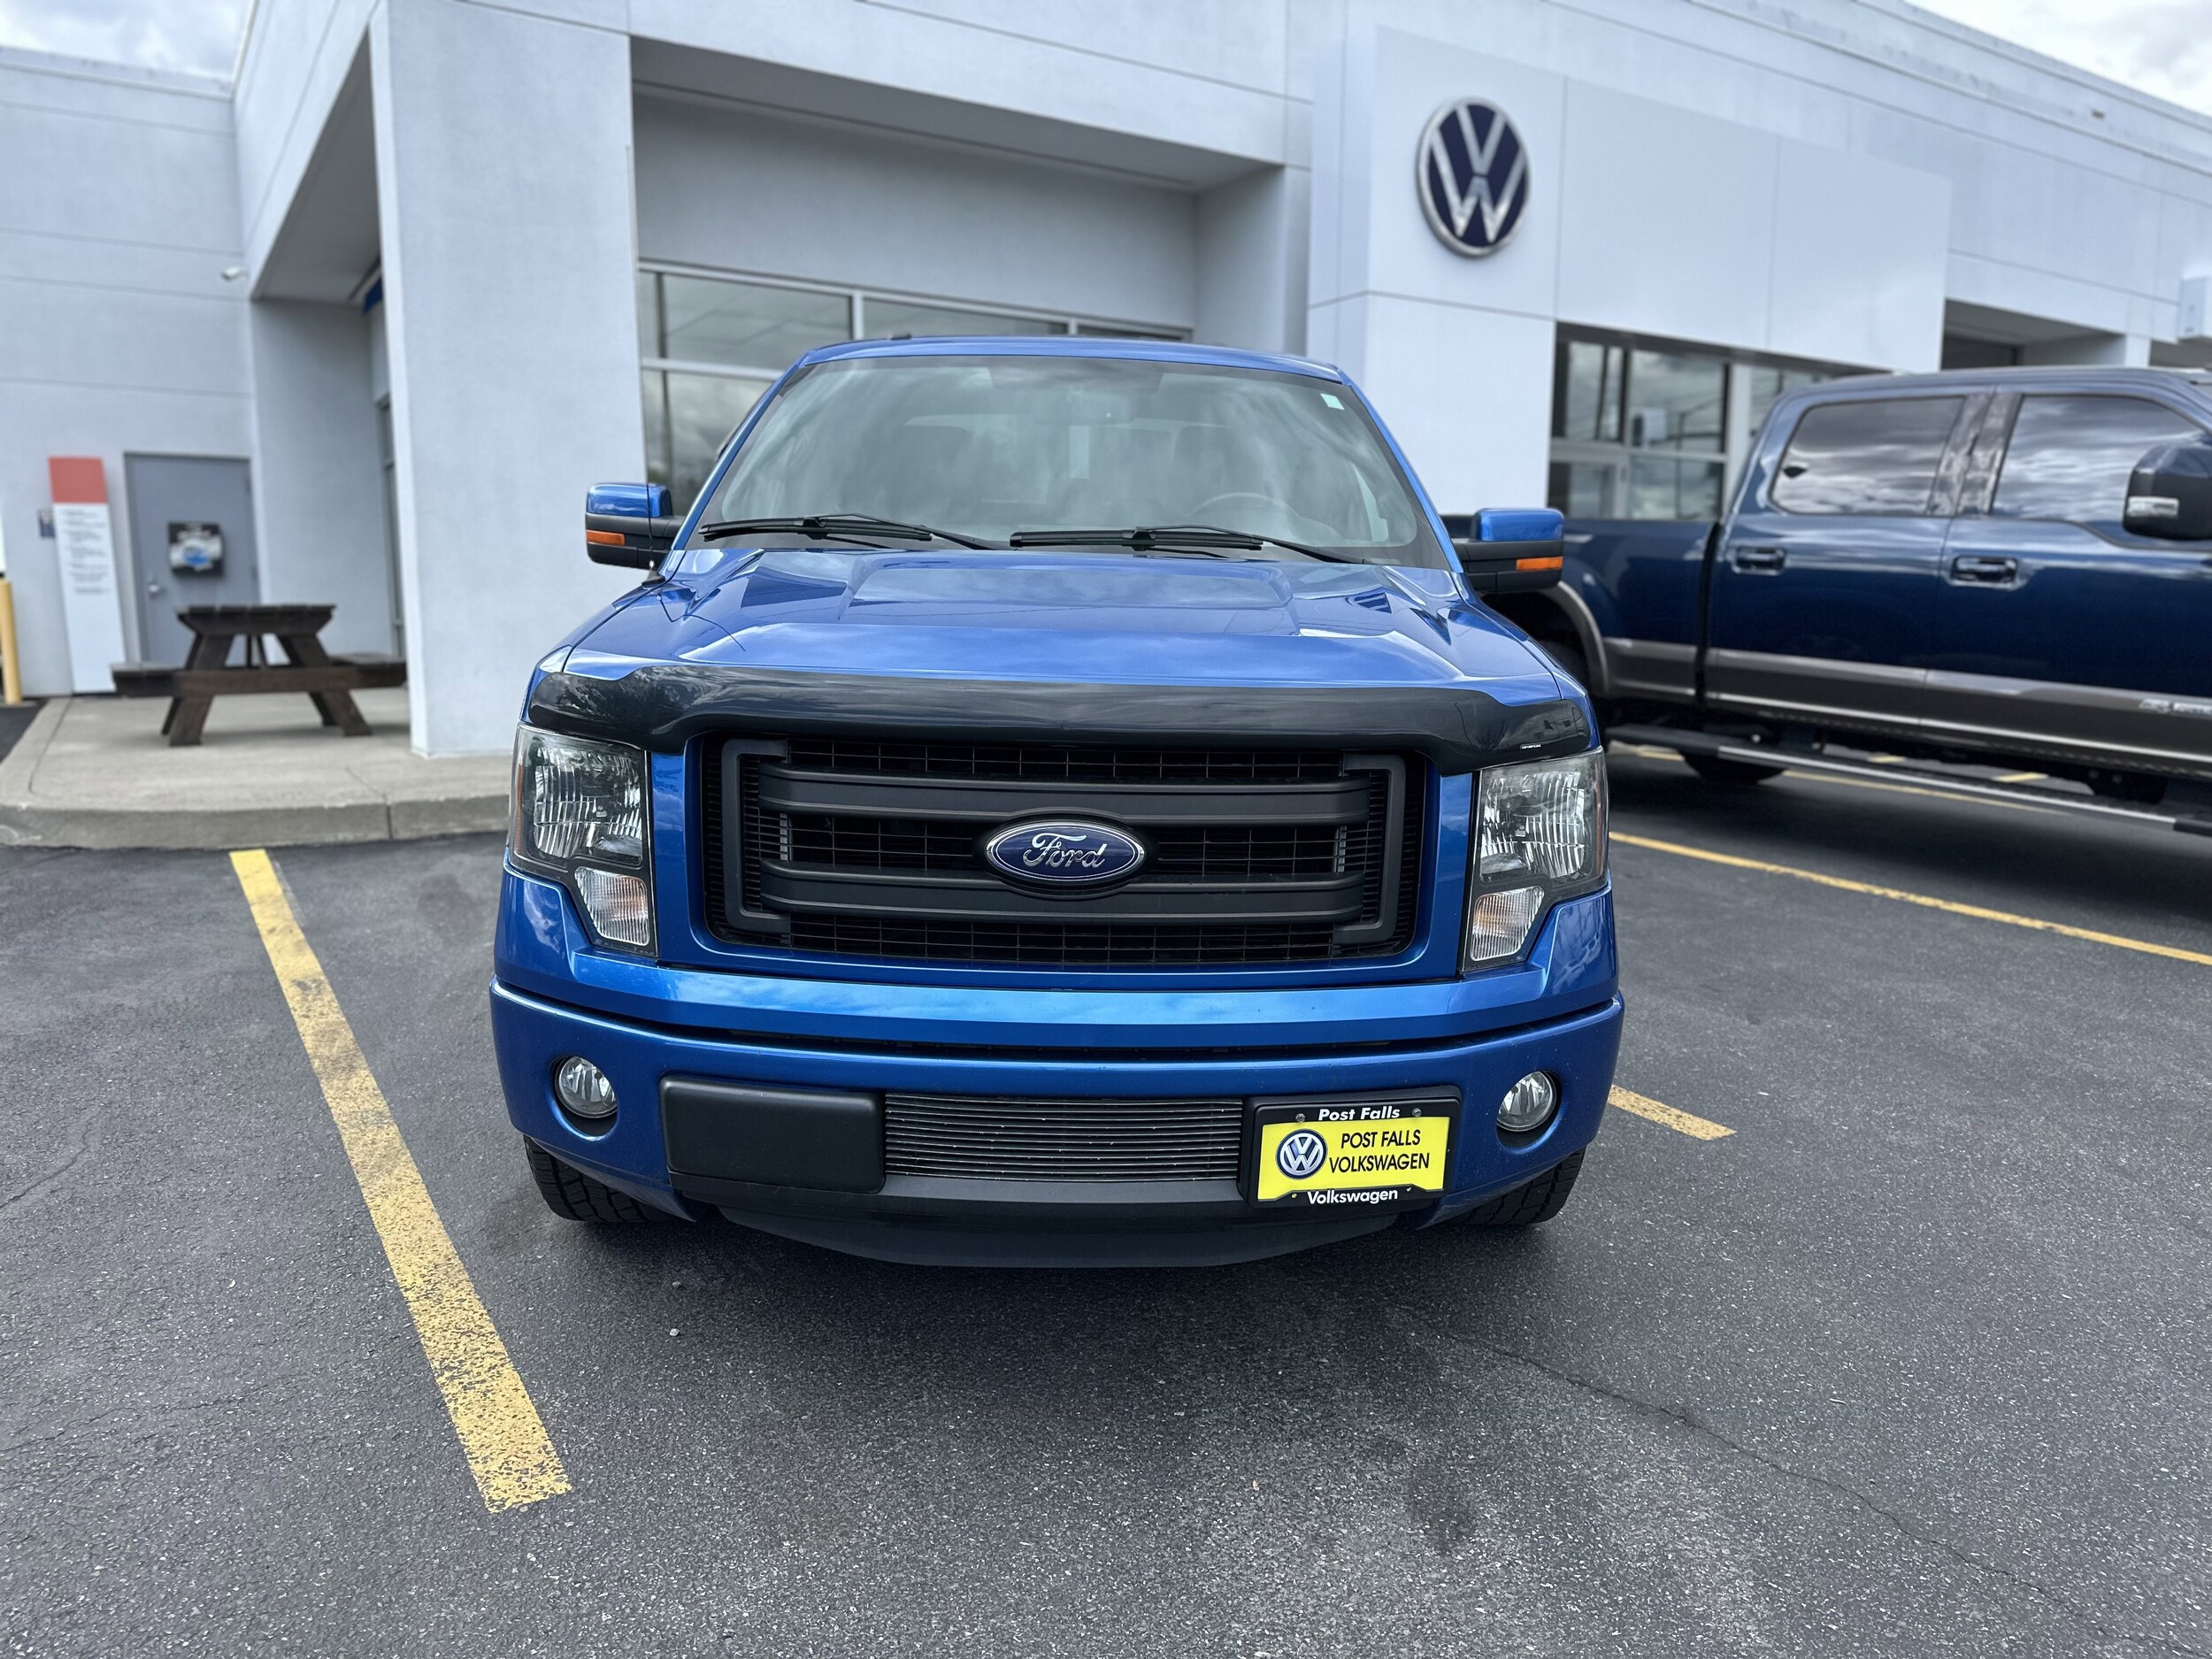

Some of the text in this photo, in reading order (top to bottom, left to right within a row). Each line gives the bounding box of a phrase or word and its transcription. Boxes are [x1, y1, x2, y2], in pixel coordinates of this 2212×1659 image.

[1427, 103, 1528, 243] VW
[1022, 832, 1108, 868] Ford
[1318, 1105, 1401, 1121] Post Falls
[1340, 1129, 1421, 1148] POST FALLS
[1279, 1133, 1323, 1174] VW
[1329, 1152, 1430, 1173] VOLKSWAGEN
[1307, 1189, 1398, 1205] Volkswagen
